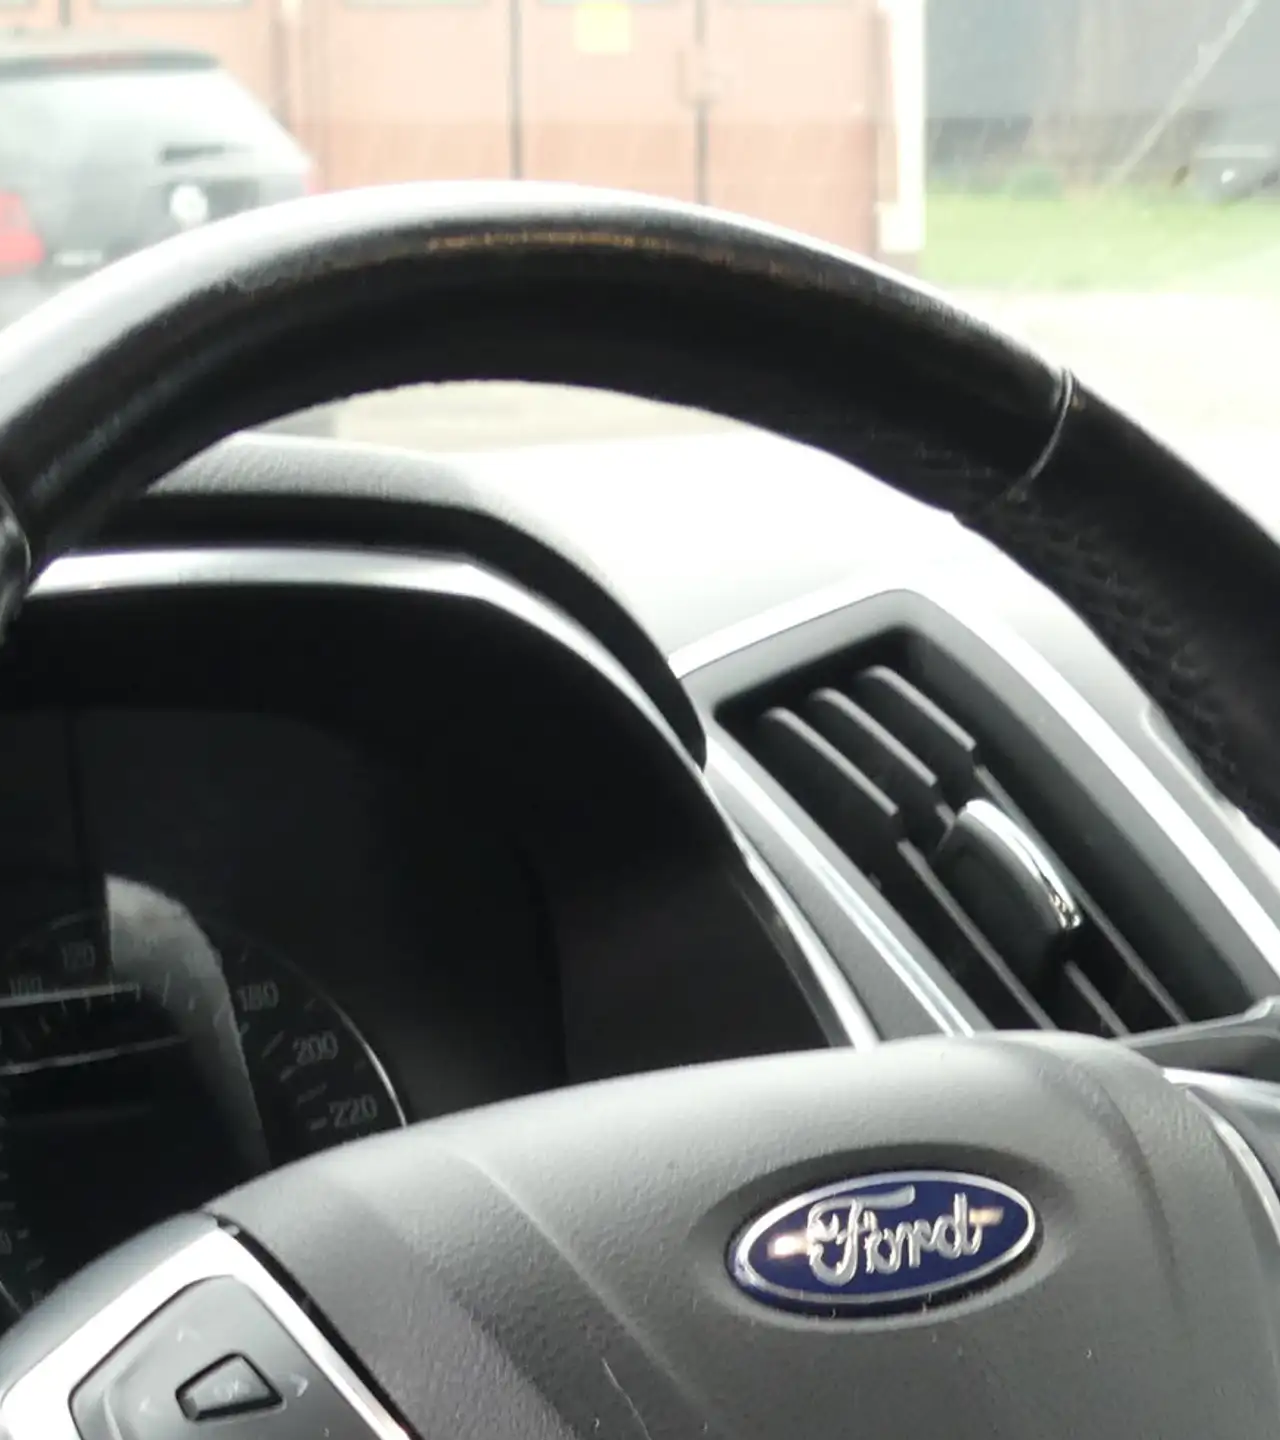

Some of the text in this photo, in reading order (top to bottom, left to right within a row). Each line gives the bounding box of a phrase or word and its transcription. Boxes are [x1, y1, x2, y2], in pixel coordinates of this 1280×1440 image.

[292, 1030, 339, 1066] 200
[327, 1093, 379, 1129] 220
[807, 1184, 983, 1287] Ford
